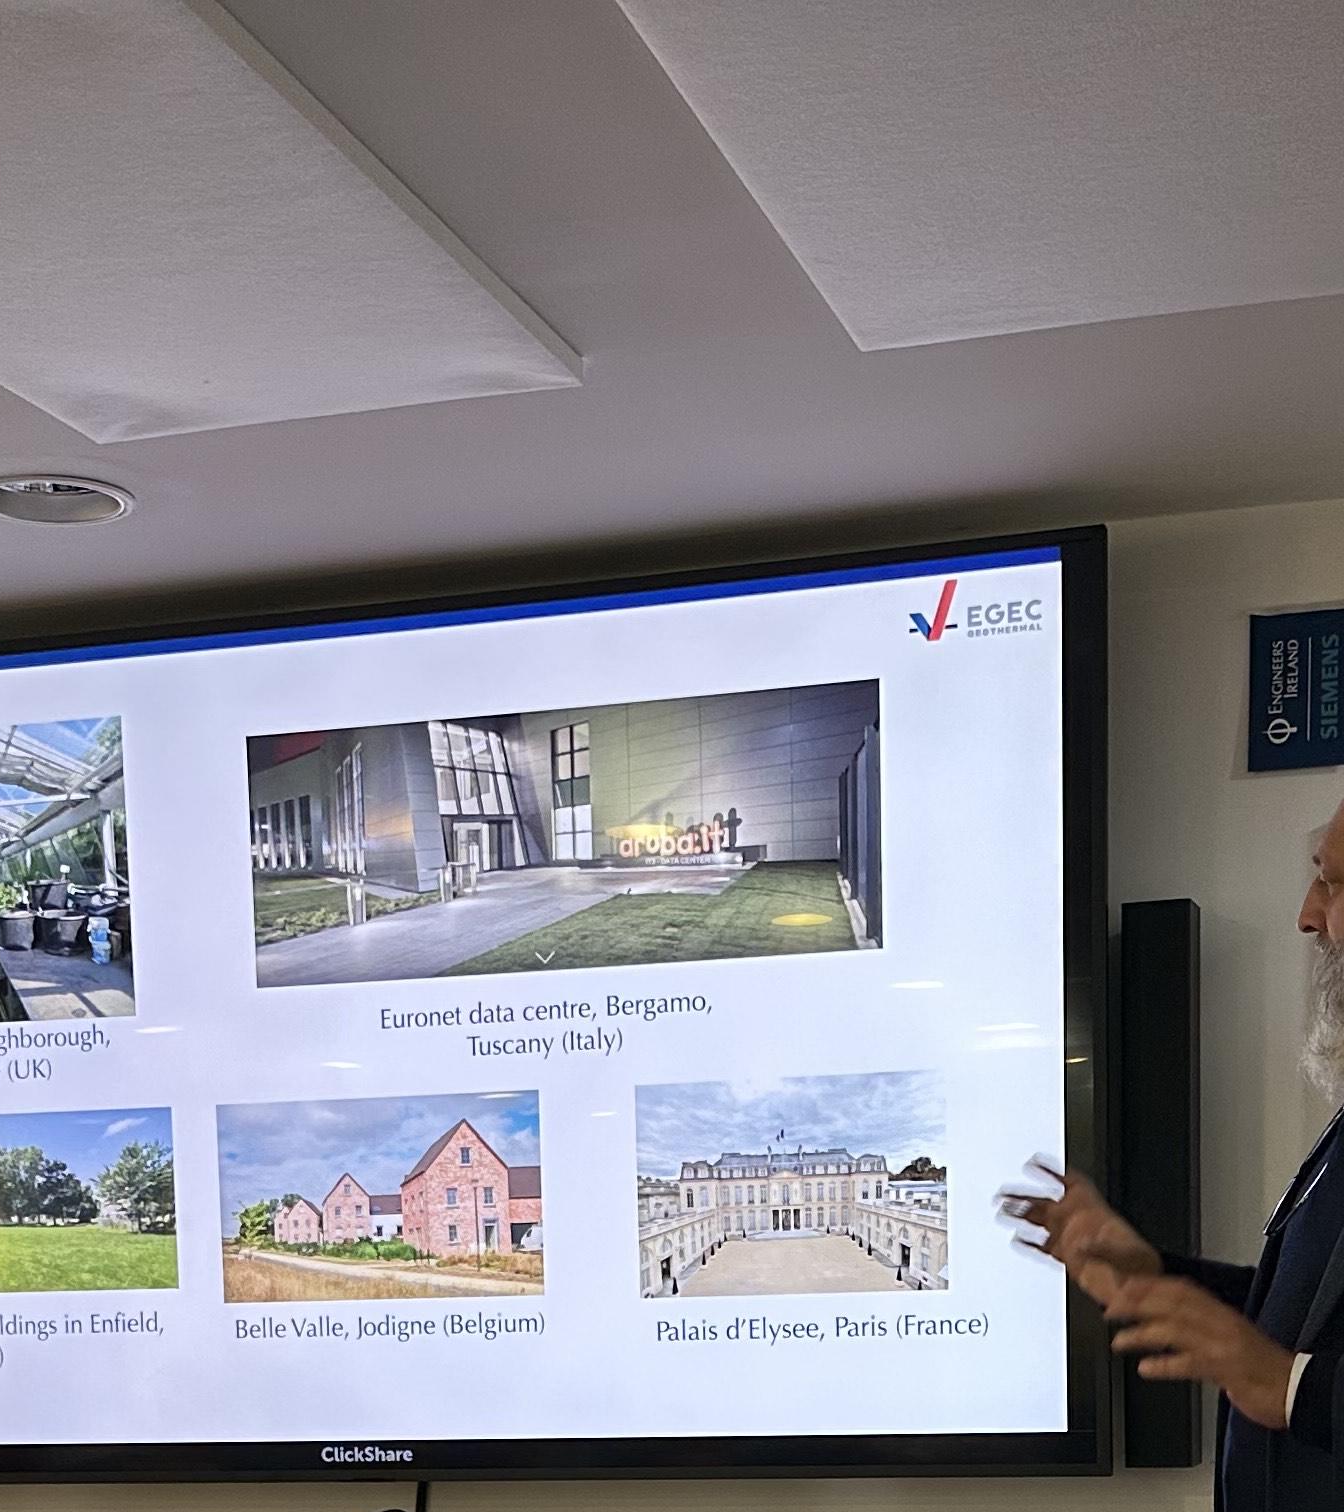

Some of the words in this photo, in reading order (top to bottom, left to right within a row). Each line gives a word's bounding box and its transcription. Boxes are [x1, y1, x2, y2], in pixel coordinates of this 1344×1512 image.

[967, 600, 1042, 627] EGEC
[967, 623, 1043, 638] GEOTHERMAL
[1268, 640, 1284, 714] ENGINEERS
[1284, 639, 1299, 698] IRELAND
[1320, 634, 1340, 739] SIEMENS
[380, 1007, 462, 1030] Euronet
[469, 1001, 514, 1024] data
[522, 1000, 597, 1021] centre,
[607, 995, 712, 1021] Bergamo,
[466, 1035, 554, 1060] Tuscany
[562, 1027, 624, 1056] (Italy)
[7, 1059, 53, 1082] (UK)
[64, 1314, 82, 1334] in
[91, 1311, 165, 1337] Enfield,
[235, 1316, 286, 1339] Belle
[290, 1315, 349, 1340] Valle,
[356, 1314, 436, 1342] Jodigne
[443, 1312, 545, 1341] (Belgium)
[656, 1318, 718, 1341] Palais
[835, 1315, 888, 1337] Paris
[896, 1313, 989, 1338] (France)
[321, 1446, 414, 1462] ClickShare
